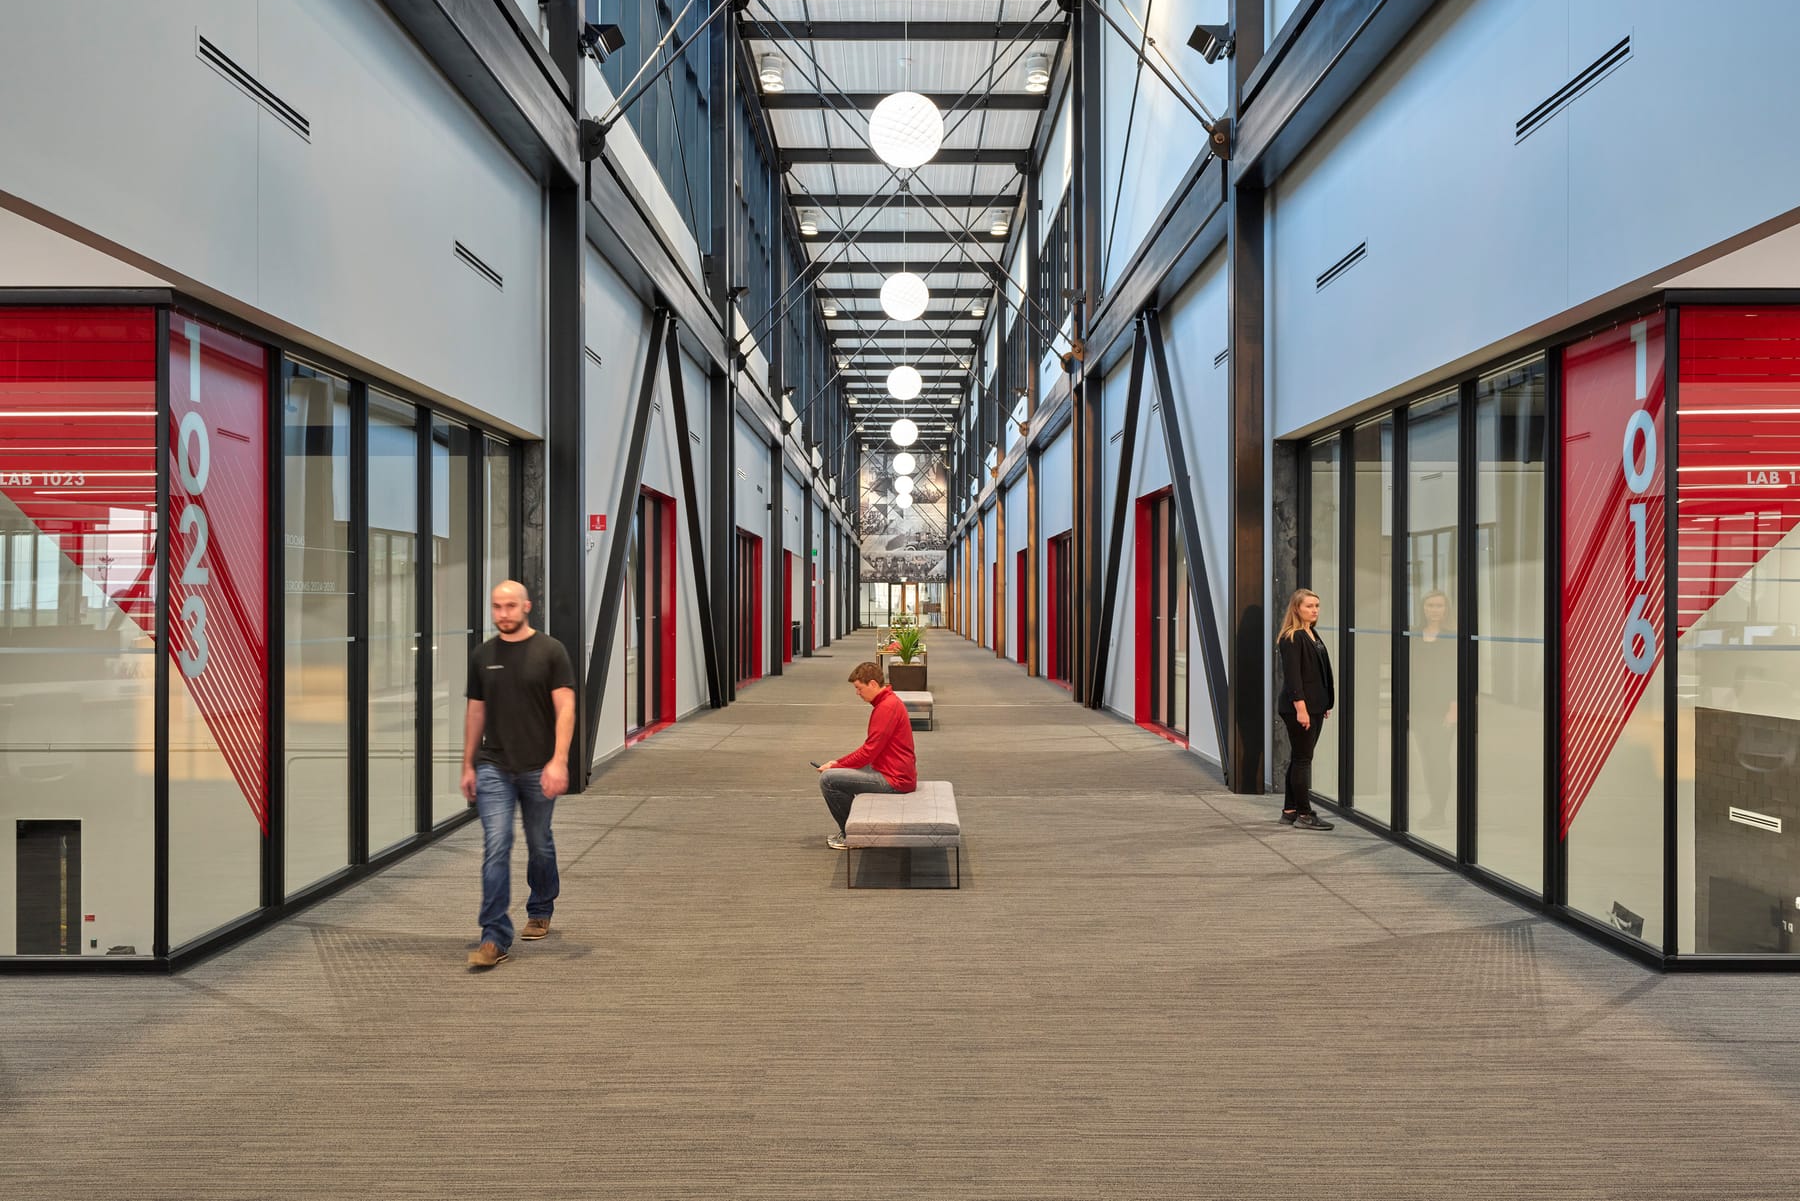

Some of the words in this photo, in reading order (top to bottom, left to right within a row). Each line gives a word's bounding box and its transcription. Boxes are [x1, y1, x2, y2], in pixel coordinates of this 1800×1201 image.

[0, 472, 32, 486] LAB
[42, 472, 86, 486] 1023
[178, 320, 210, 679] 1023
[1623, 320, 1657, 675] 1016
[1747, 471, 1780, 485] LAB
